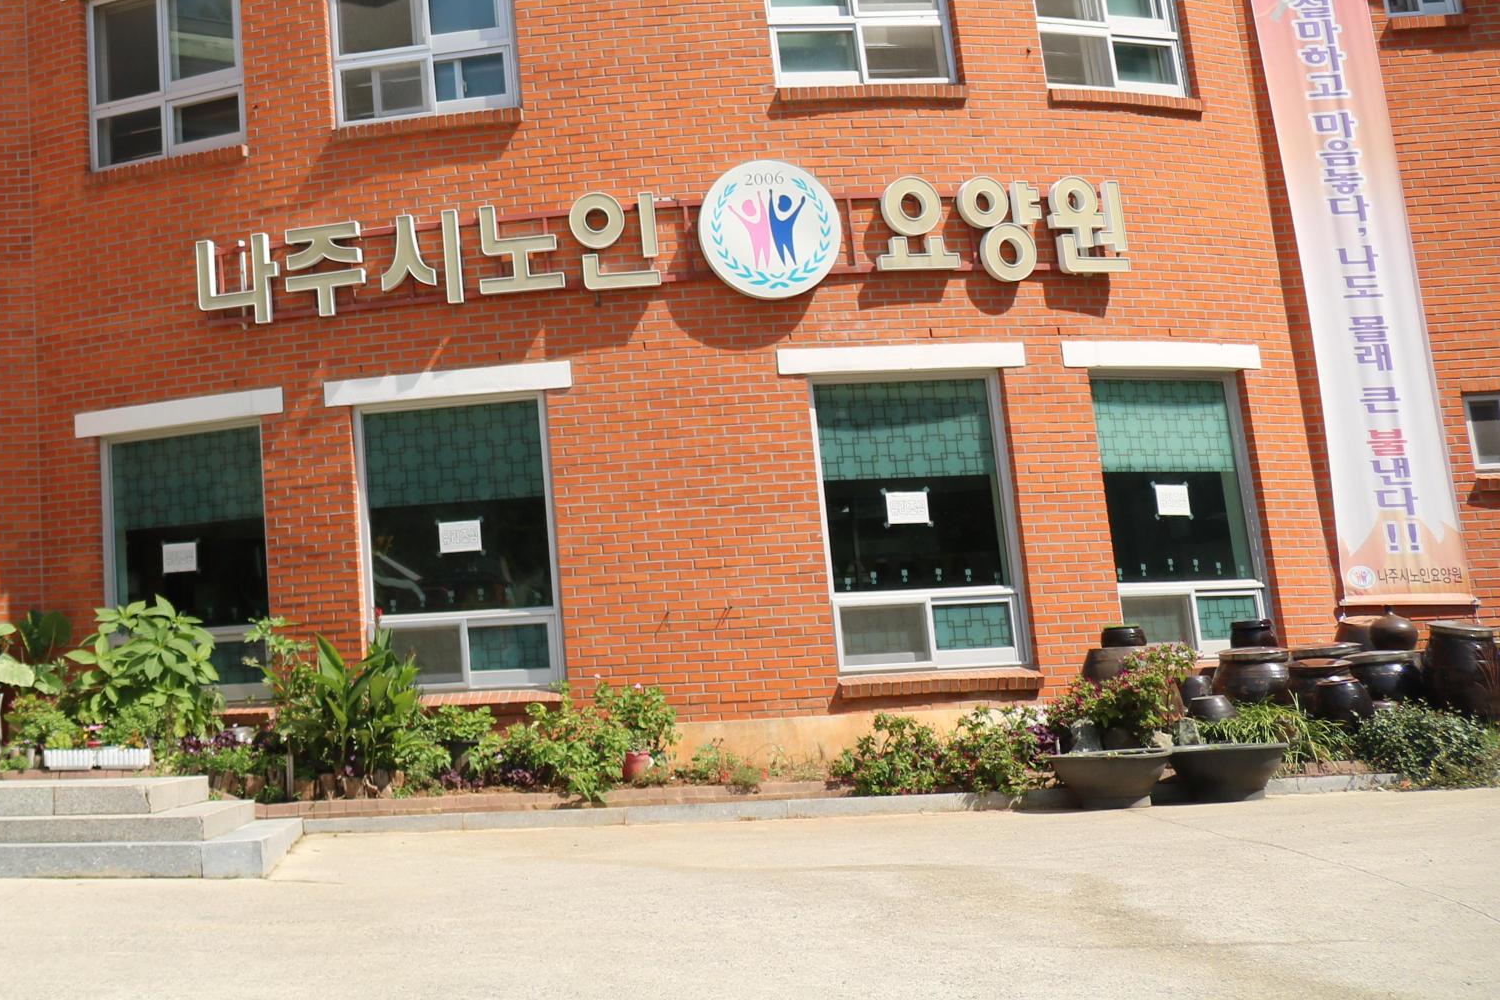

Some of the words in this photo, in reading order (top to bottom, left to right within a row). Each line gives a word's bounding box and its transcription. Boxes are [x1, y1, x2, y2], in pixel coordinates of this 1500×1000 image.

[744, 170, 785, 186] 2006
[876, 175, 1132, 283] 요양원
[1336, 245, 1384, 299] 나도
[1348, 315, 1393, 372] 몰래
[1359, 386, 1401, 414] 큰
